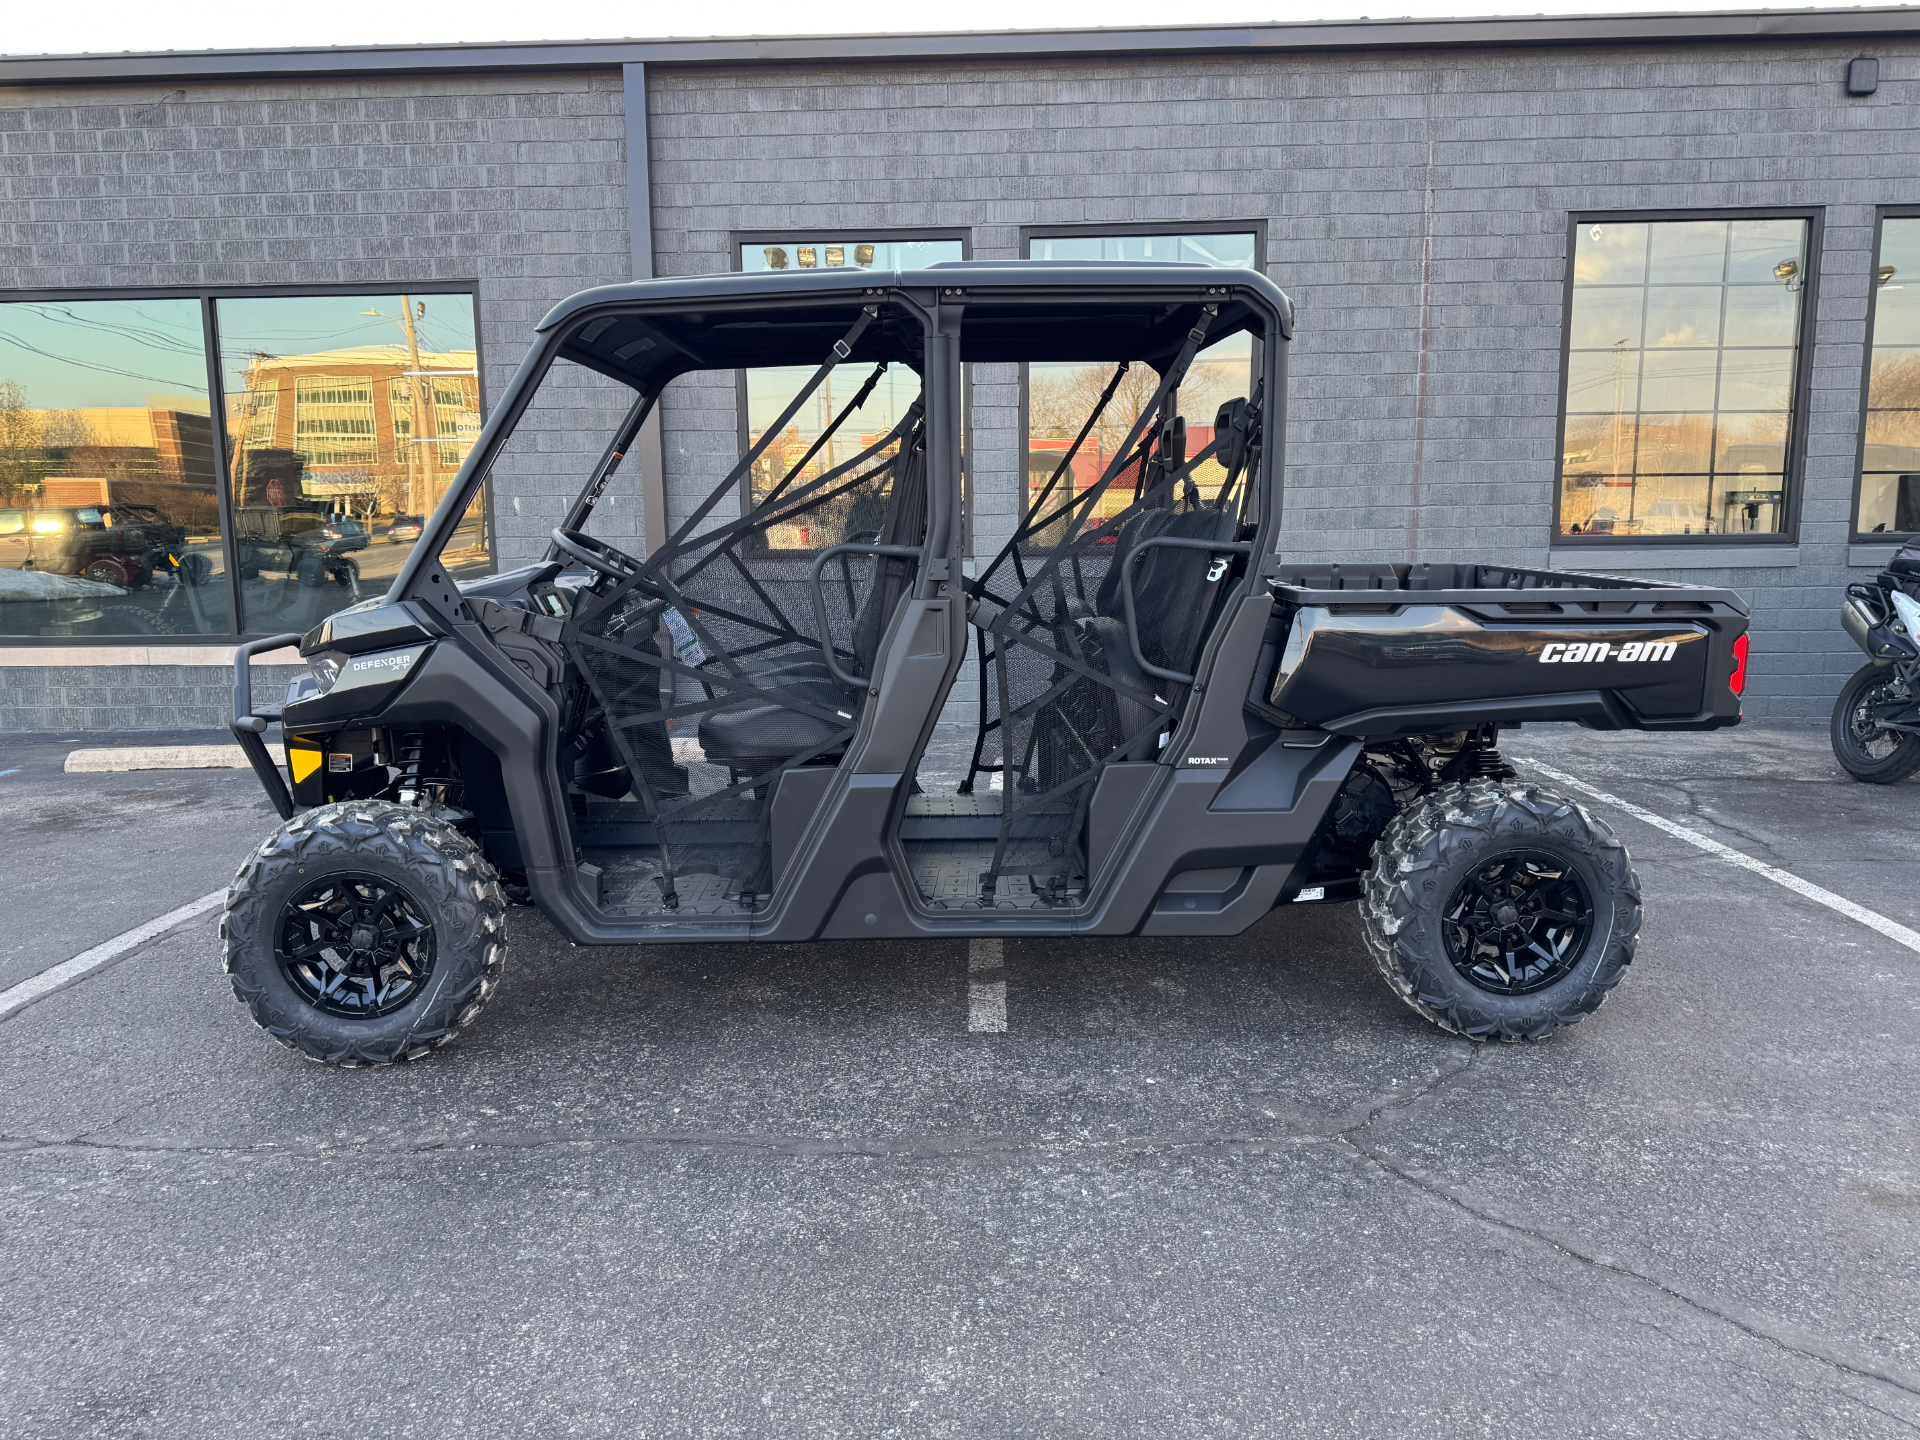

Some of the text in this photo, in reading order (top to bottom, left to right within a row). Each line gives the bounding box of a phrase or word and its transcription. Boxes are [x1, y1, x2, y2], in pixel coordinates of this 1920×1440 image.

[353, 655, 411, 671] DEFENDER
[391, 663, 411, 671] XT
[1188, 757, 1217, 765] ROTAX
